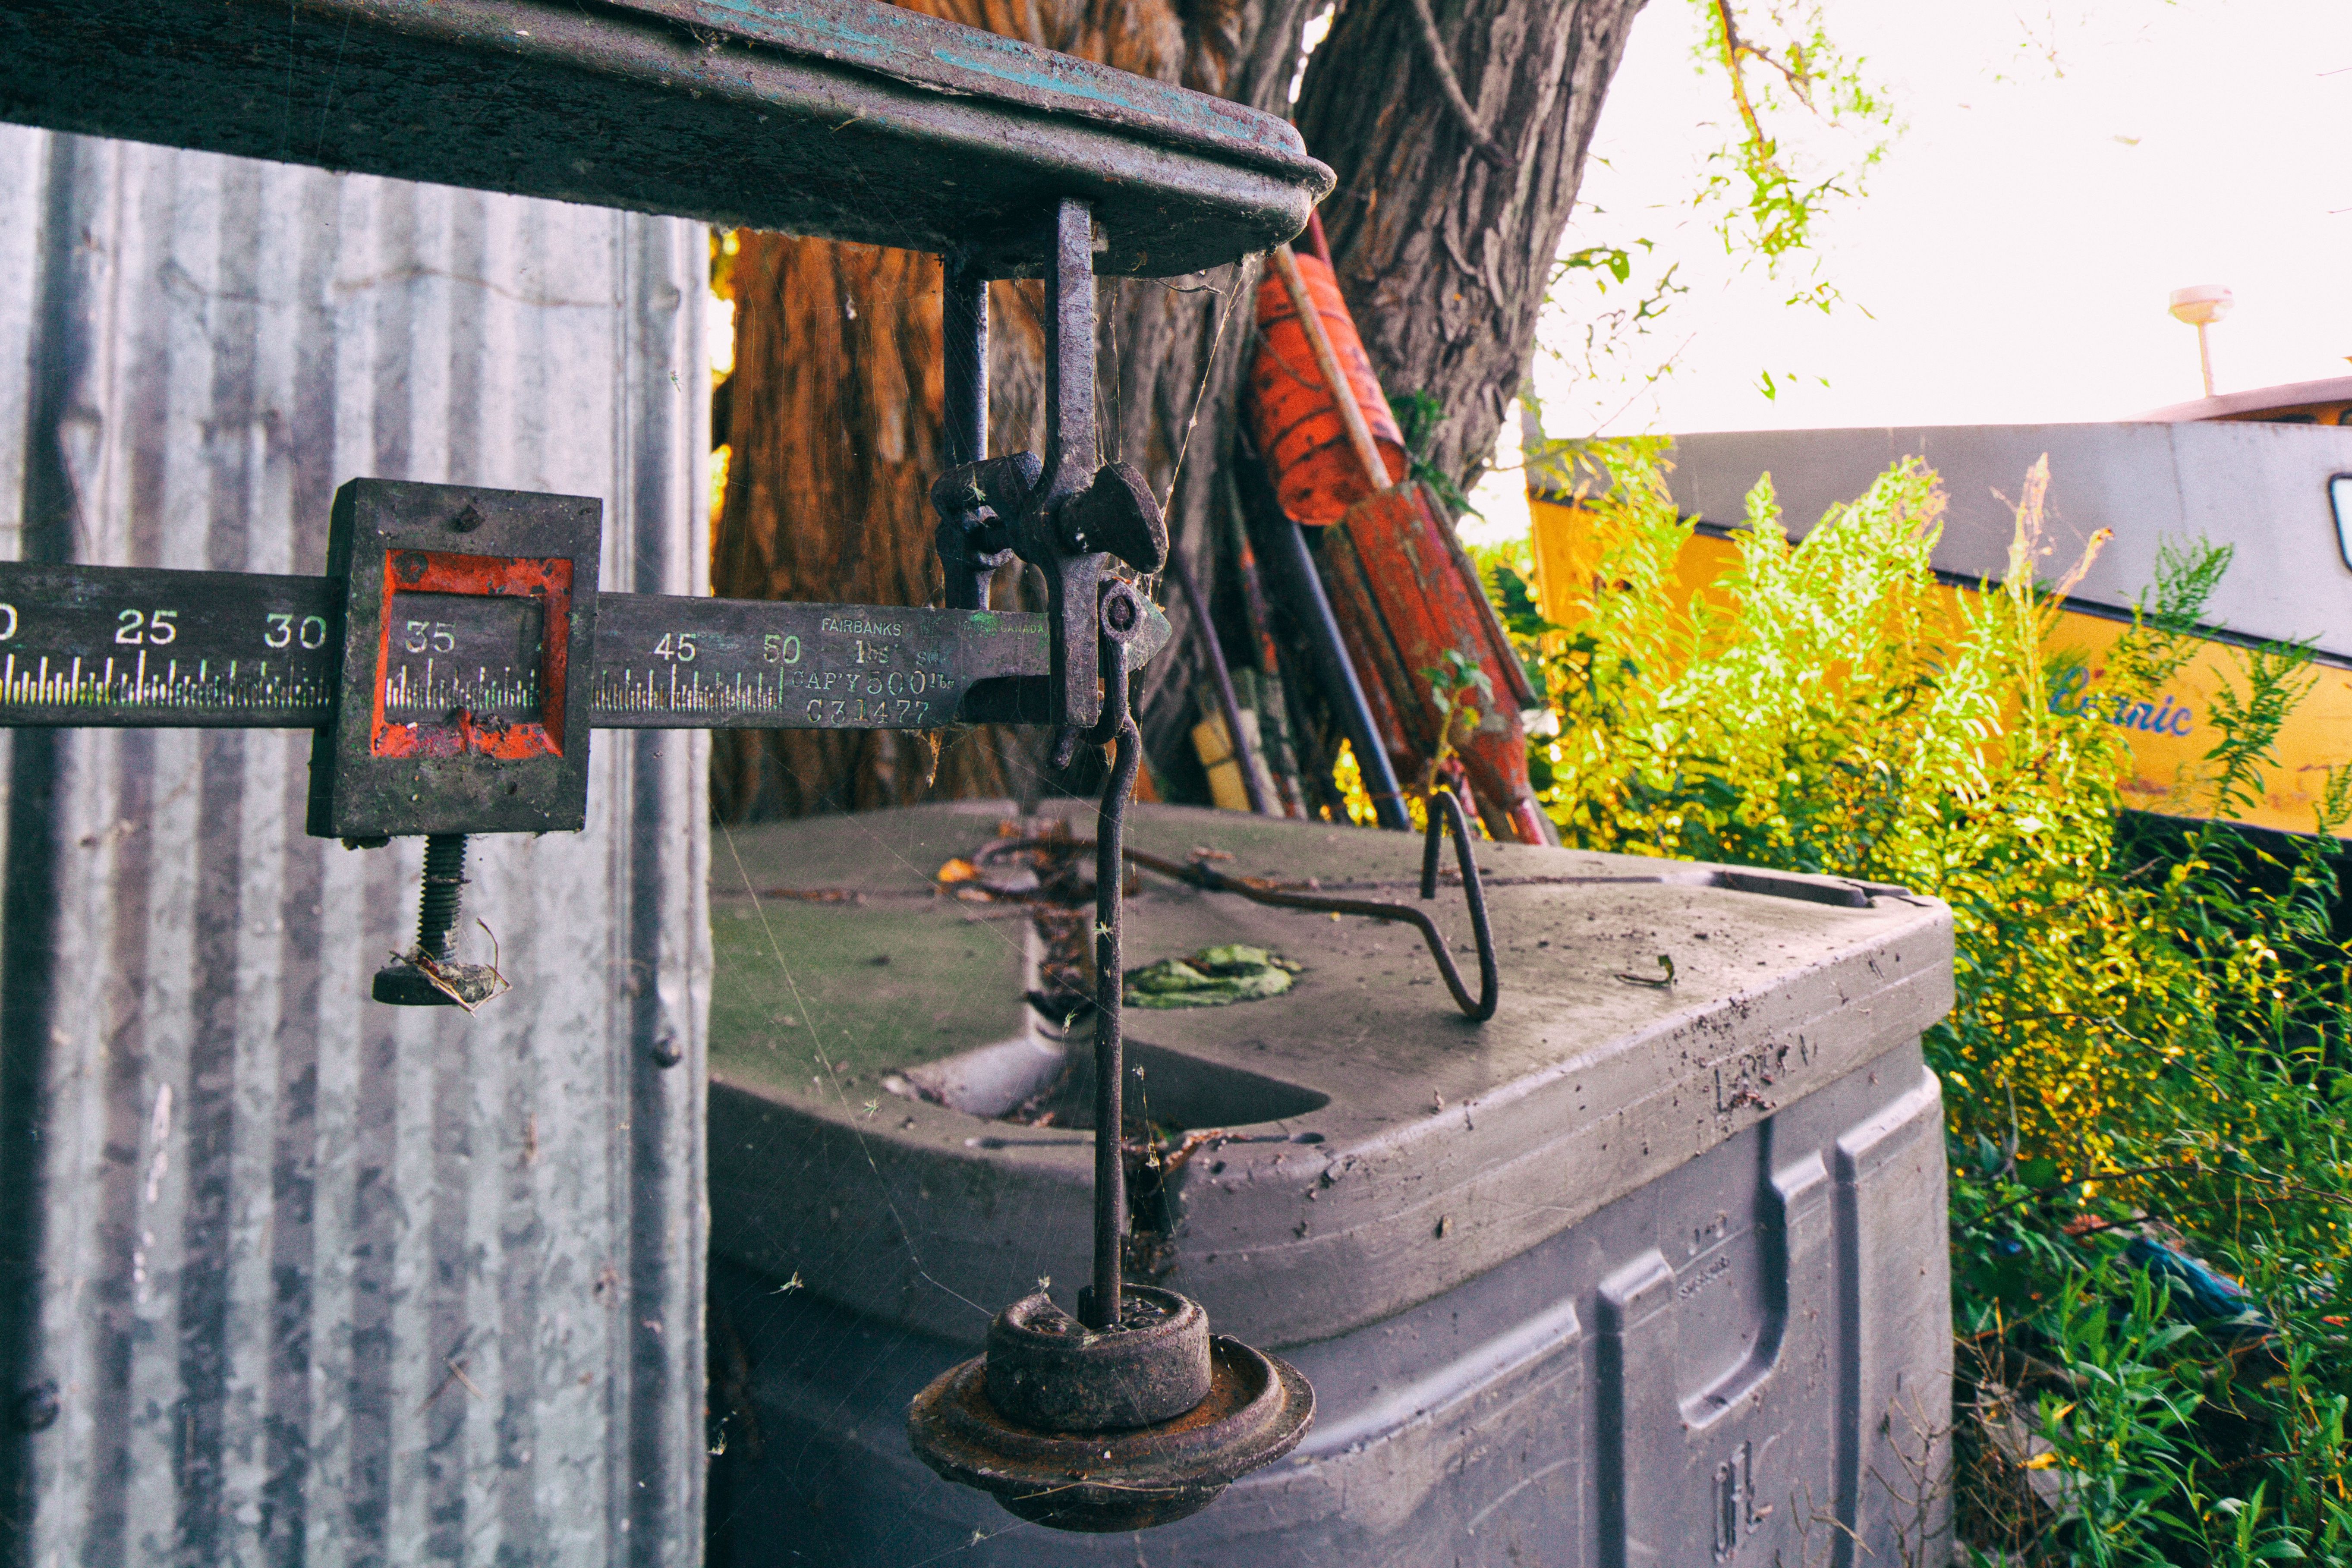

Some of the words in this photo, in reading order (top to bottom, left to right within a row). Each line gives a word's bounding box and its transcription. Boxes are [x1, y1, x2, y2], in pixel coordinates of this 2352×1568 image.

[115, 609, 177, 645] 25
[264, 613, 327, 649] 30
[405, 620, 456, 653] 35
[654, 633, 696, 662] 45
[763, 633, 801, 664] 50
[822, 618, 902, 636] FAIRBANKS
[1001, 624, 1044, 634] CANADA
[807, 699, 930, 724] C31477
